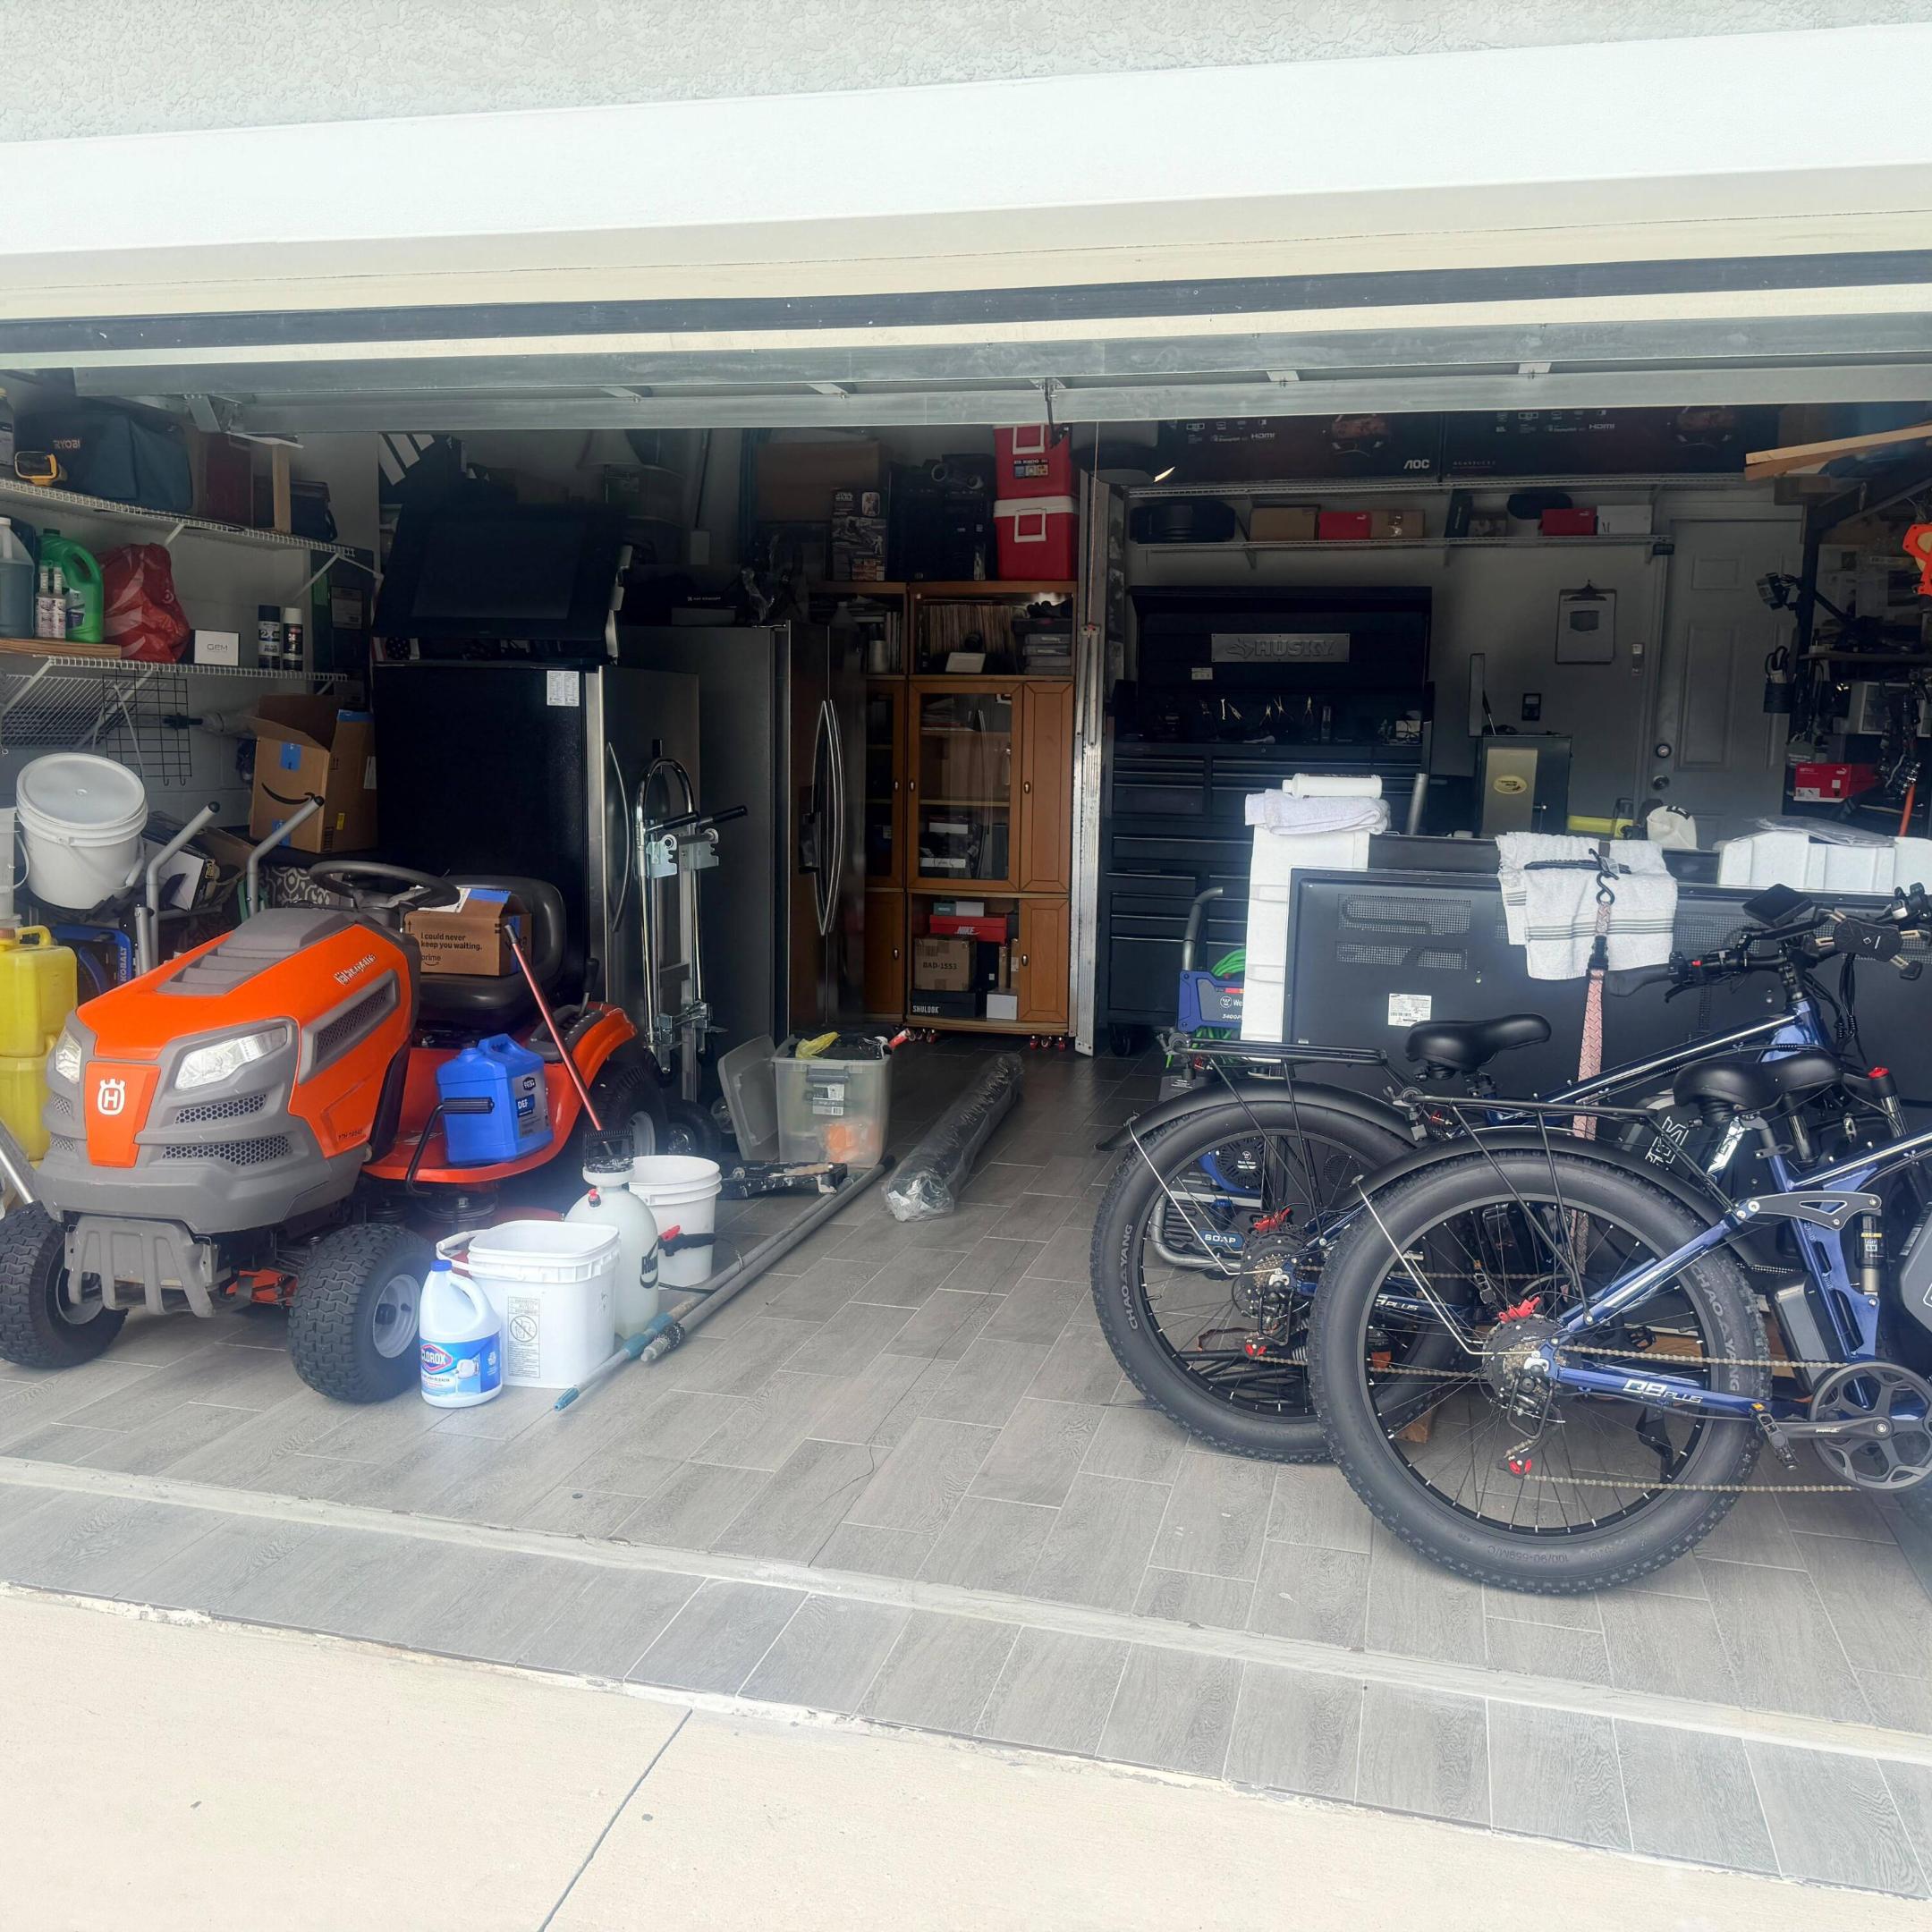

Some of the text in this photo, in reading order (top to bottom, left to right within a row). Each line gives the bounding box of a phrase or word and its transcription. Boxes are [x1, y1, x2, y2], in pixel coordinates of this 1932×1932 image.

[53, 439, 80, 450] RYOBI
[1403, 459, 1431, 470] AOC
[207, 643, 229, 652] GEM
[1254, 640, 1335, 657] HUSKY
[424, 932, 445, 940] could
[956, 926, 976, 935] NIKE
[420, 940, 483, 952] keep you waiting.
[119, 945, 128, 983] KOBALT
[517, 1098, 529, 1110] DEF
[1204, 1233, 1237, 1244] SOAP
[1120, 1224, 1139, 1330] CHAO YANG
[1690, 1264, 1724, 1318] CHAO
